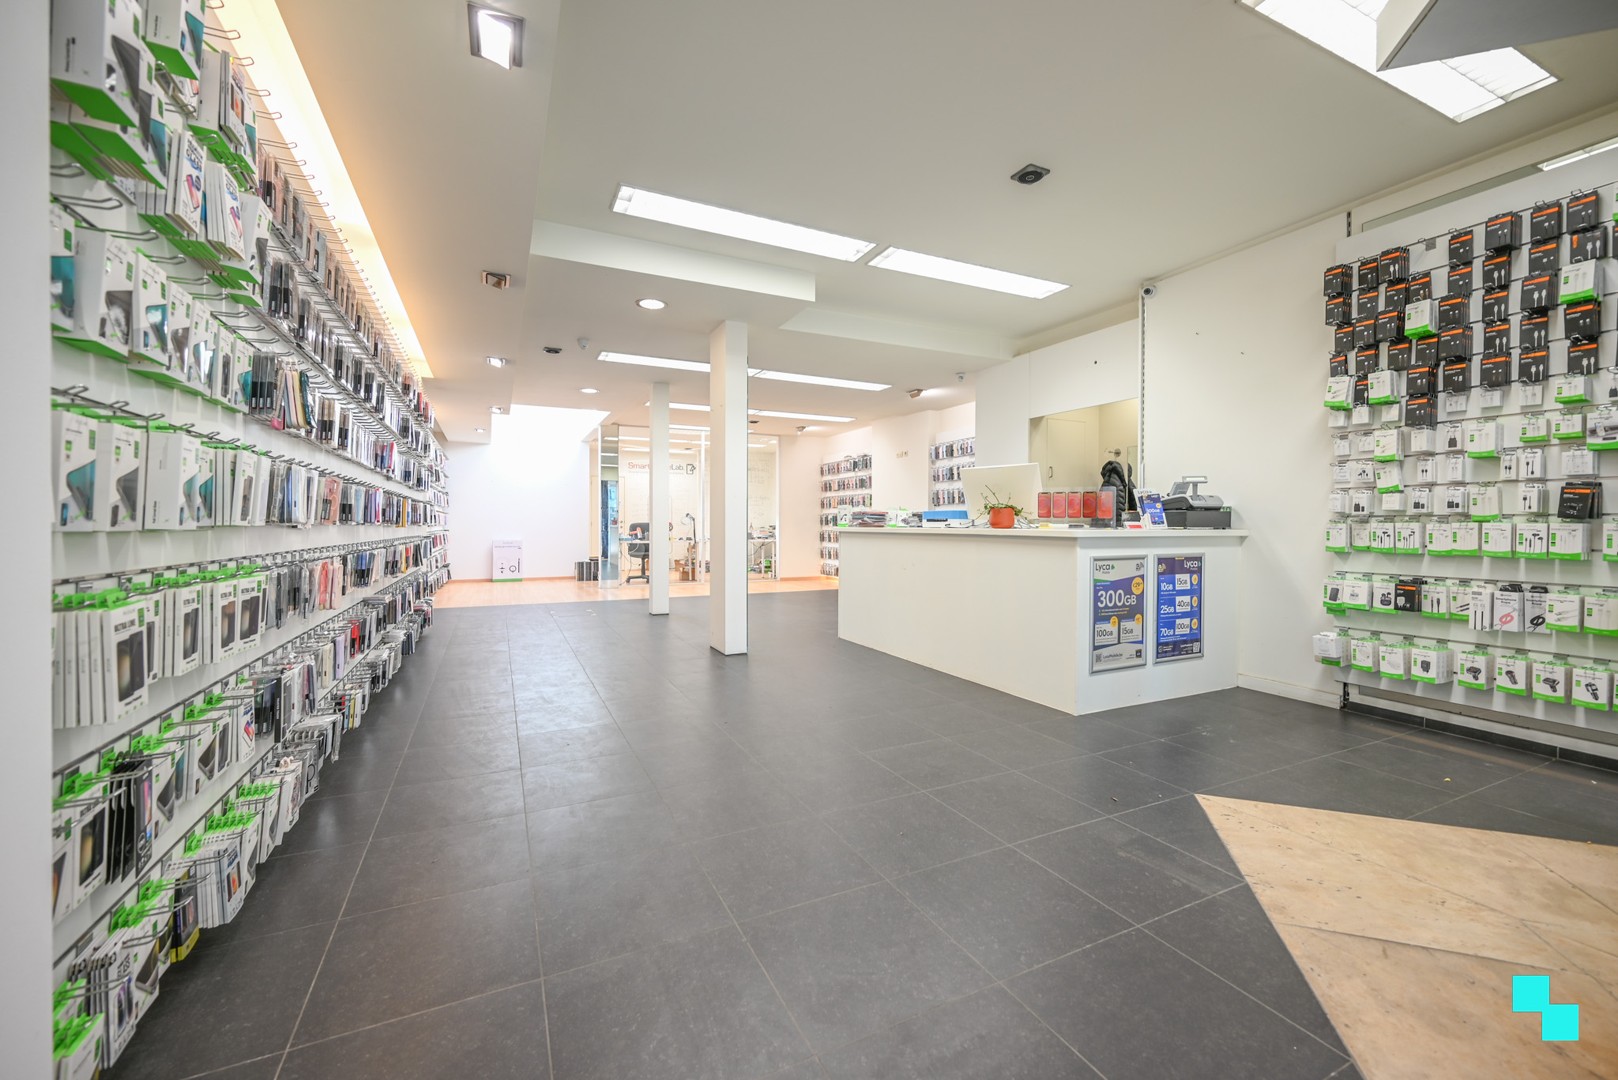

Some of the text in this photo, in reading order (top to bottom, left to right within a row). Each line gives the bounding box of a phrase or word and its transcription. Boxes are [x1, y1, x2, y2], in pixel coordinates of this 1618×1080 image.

[1095, 563, 1111, 573] Lyca
[1184, 560, 1198, 569] Lyca
[1097, 589, 1137, 608] 300GB
[1177, 599, 1190, 608] 40GB
[1160, 605, 1175, 614] 25GB
[1096, 629, 1114, 638] 100GB
[1121, 626, 1134, 636] 15GB
[1160, 627, 1174, 637] 70GB
